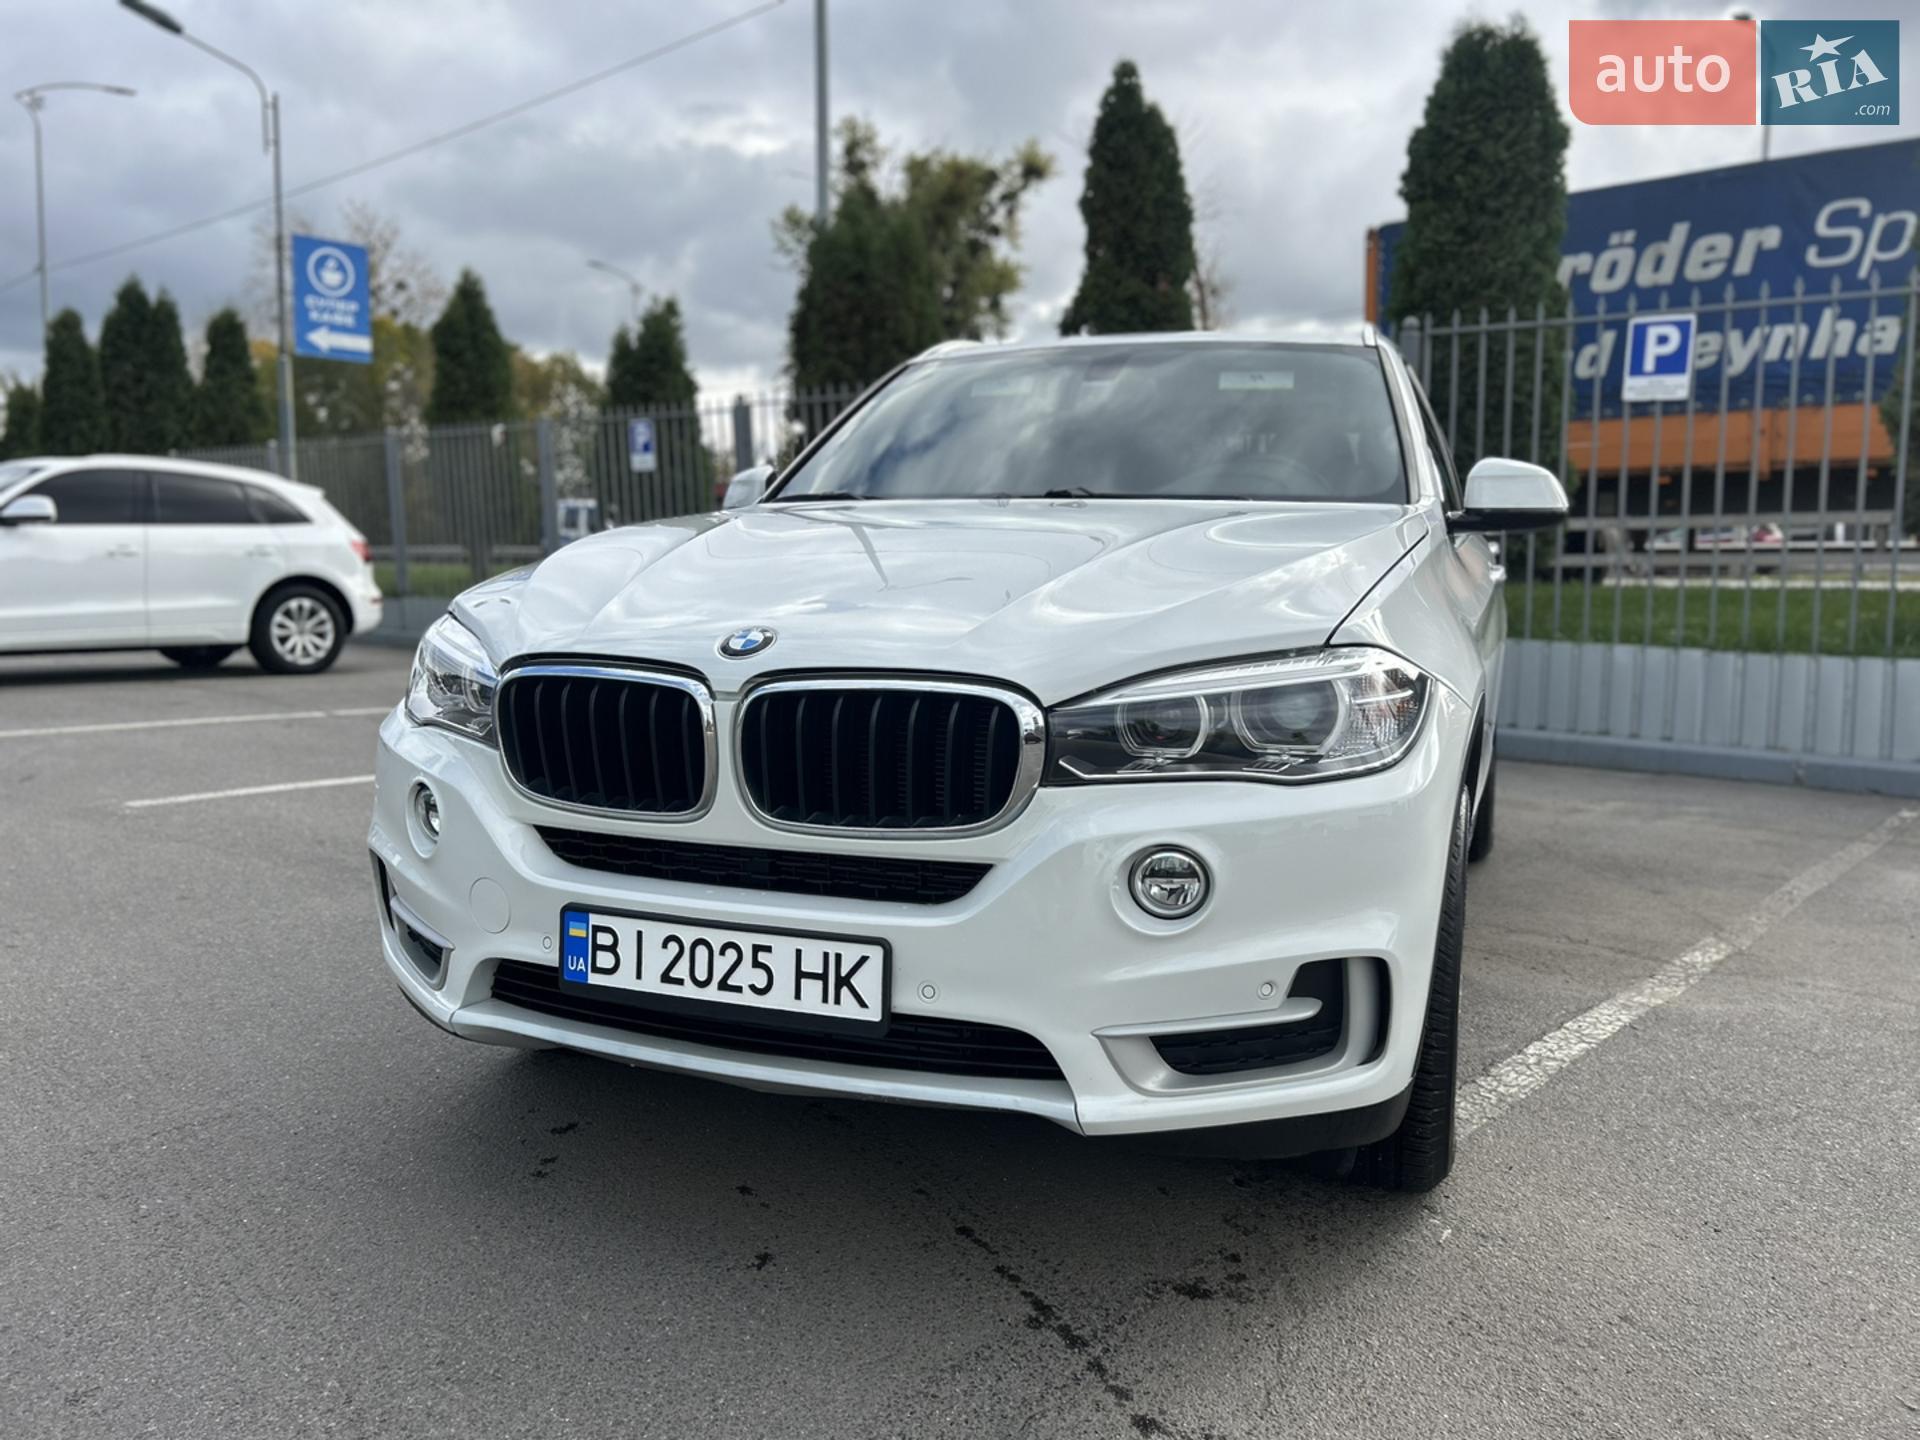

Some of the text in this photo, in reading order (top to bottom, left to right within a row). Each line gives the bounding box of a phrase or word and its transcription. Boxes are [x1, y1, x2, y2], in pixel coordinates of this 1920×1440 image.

[1643, 323, 1682, 374] P
[567, 954, 587, 973] UA
[590, 923, 871, 1009] BI 2025 HK
